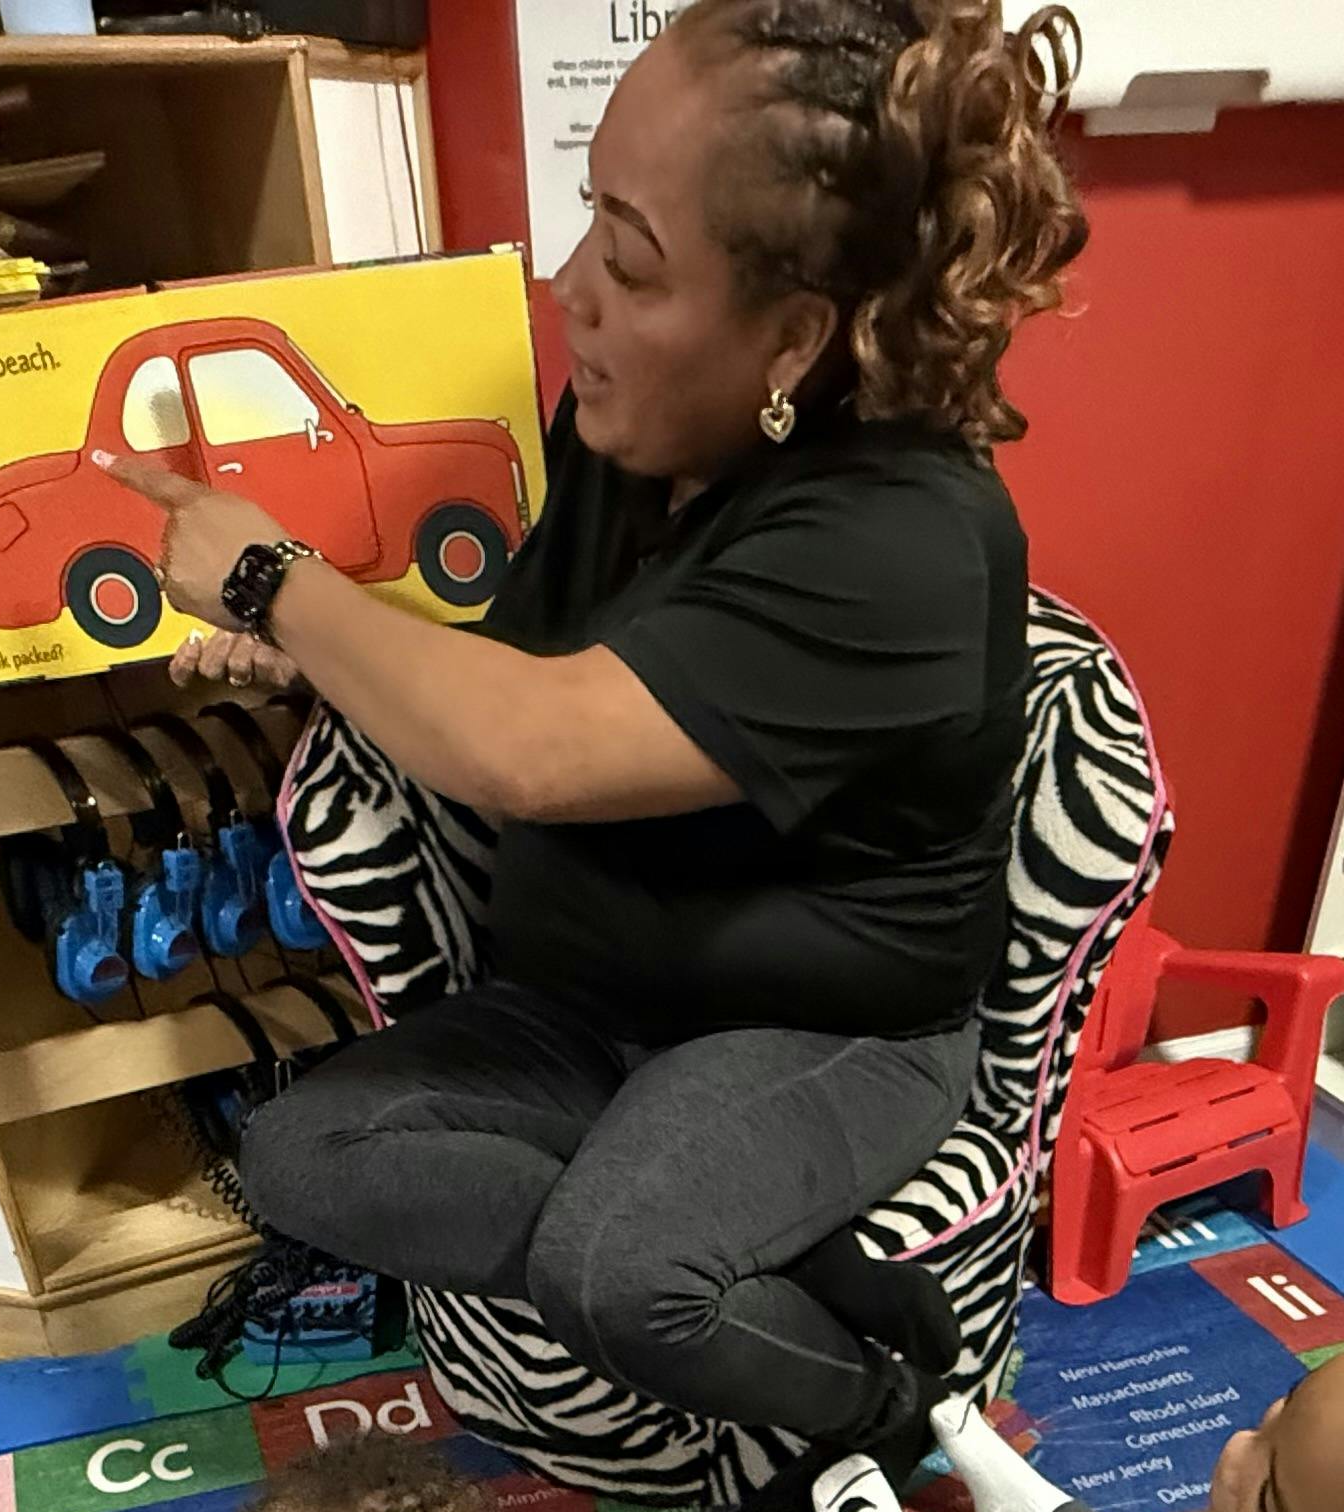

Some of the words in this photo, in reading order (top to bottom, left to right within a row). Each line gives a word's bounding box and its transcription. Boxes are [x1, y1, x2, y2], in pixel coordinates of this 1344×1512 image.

[12, 643, 64, 672] packed?
[1059, 1365, 1102, 1383] New
[1101, 1344, 1191, 1374] Hampshire
[1071, 1370, 1194, 1410] Massachusetts
[1129, 1401, 1188, 1424] Rhode
[1188, 1385, 1241, 1411] Island
[304, 1381, 433, 1449] Dd
[1125, 1413, 1232, 1449] Connecticut
[87, 1438, 194, 1493] Cc
[1071, 1469, 1116, 1492] New
[1117, 1454, 1173, 1481] Jersey
